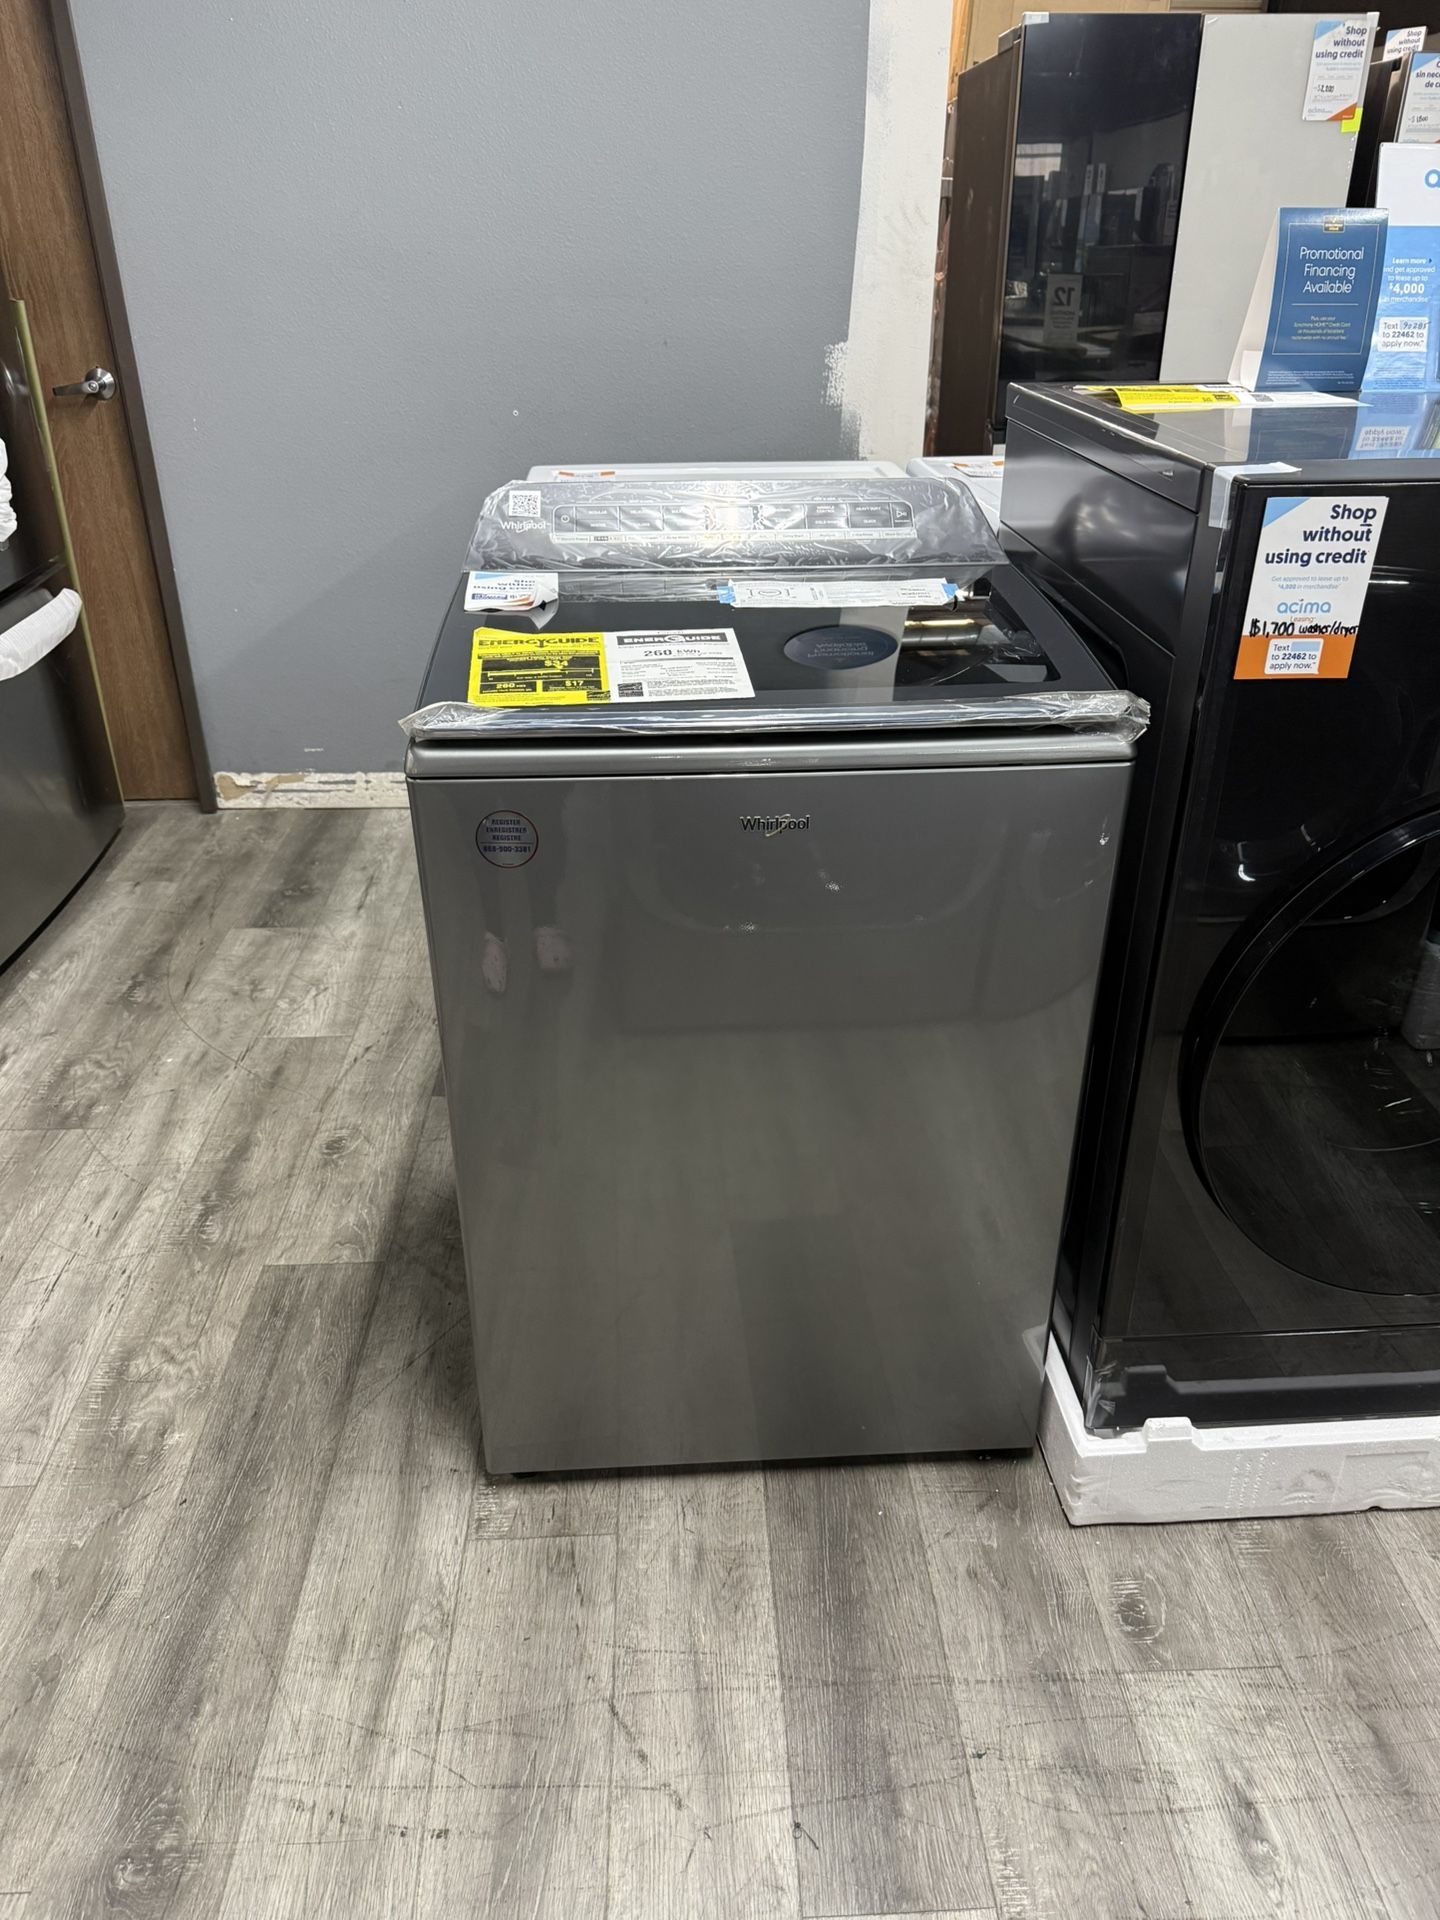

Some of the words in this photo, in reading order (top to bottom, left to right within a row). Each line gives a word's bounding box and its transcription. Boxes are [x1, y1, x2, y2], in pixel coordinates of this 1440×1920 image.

[1346, 26, 1367, 36] Shop
[1333, 38, 1365, 47] without
[1315, 50, 1338, 60] using
[1340, 49, 1363, 58] credit
[1300, 246, 1365, 260] Promotional
[1304, 263, 1356, 280] Financing
[1406, 265, 1435, 274] approved
[1389, 283, 1425, 295] $4,000
[1382, 340, 1402, 348] apply
[1330, 504, 1377, 523] Shop
[501, 520, 546, 534] Whirlpool
[1303, 526, 1371, 542] without
[1265, 549, 1311, 567] using
[1315, 549, 1367, 564] credit
[1276, 598, 1331, 614] acima
[478, 636, 600, 648] ENERGYGUIDE
[622, 633, 721, 644] ENERGUIDE
[1273, 643, 1290, 651] Text
[643, 649, 673, 657] 260
[1281, 652, 1307, 660] 22462
[1269, 662, 1292, 671] apply
[740, 813, 811, 837] Whirlpool
